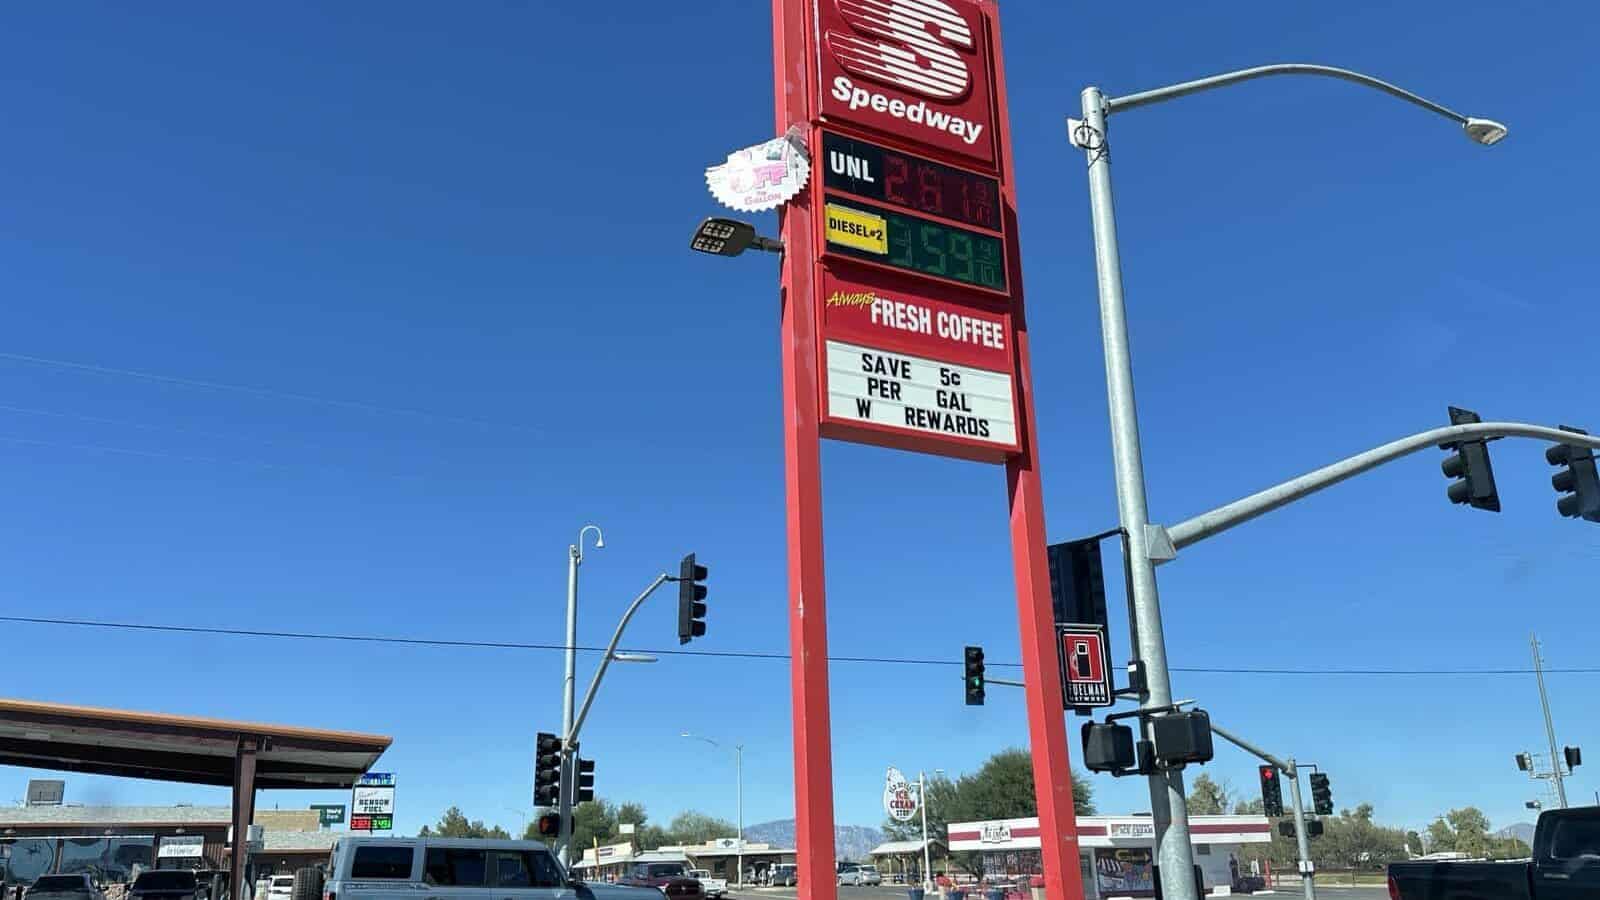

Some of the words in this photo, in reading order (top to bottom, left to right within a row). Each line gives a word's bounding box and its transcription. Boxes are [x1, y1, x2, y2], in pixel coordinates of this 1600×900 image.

[831, 77, 983, 144] Speedway
[830, 151, 874, 183] UNL
[826, 290, 876, 310] Always
[871, 297, 932, 335] FRESH
[937, 311, 1005, 350] COFFEE
[862, 353, 911, 380] SAVE
[867, 377, 901, 401] PER
[936, 389, 972, 413] GAL
[856, 399, 871, 419] W
[904, 406, 990, 438] REWARDS
[890, 800, 915, 809] CREAM
[895, 790, 909, 799] ICE
